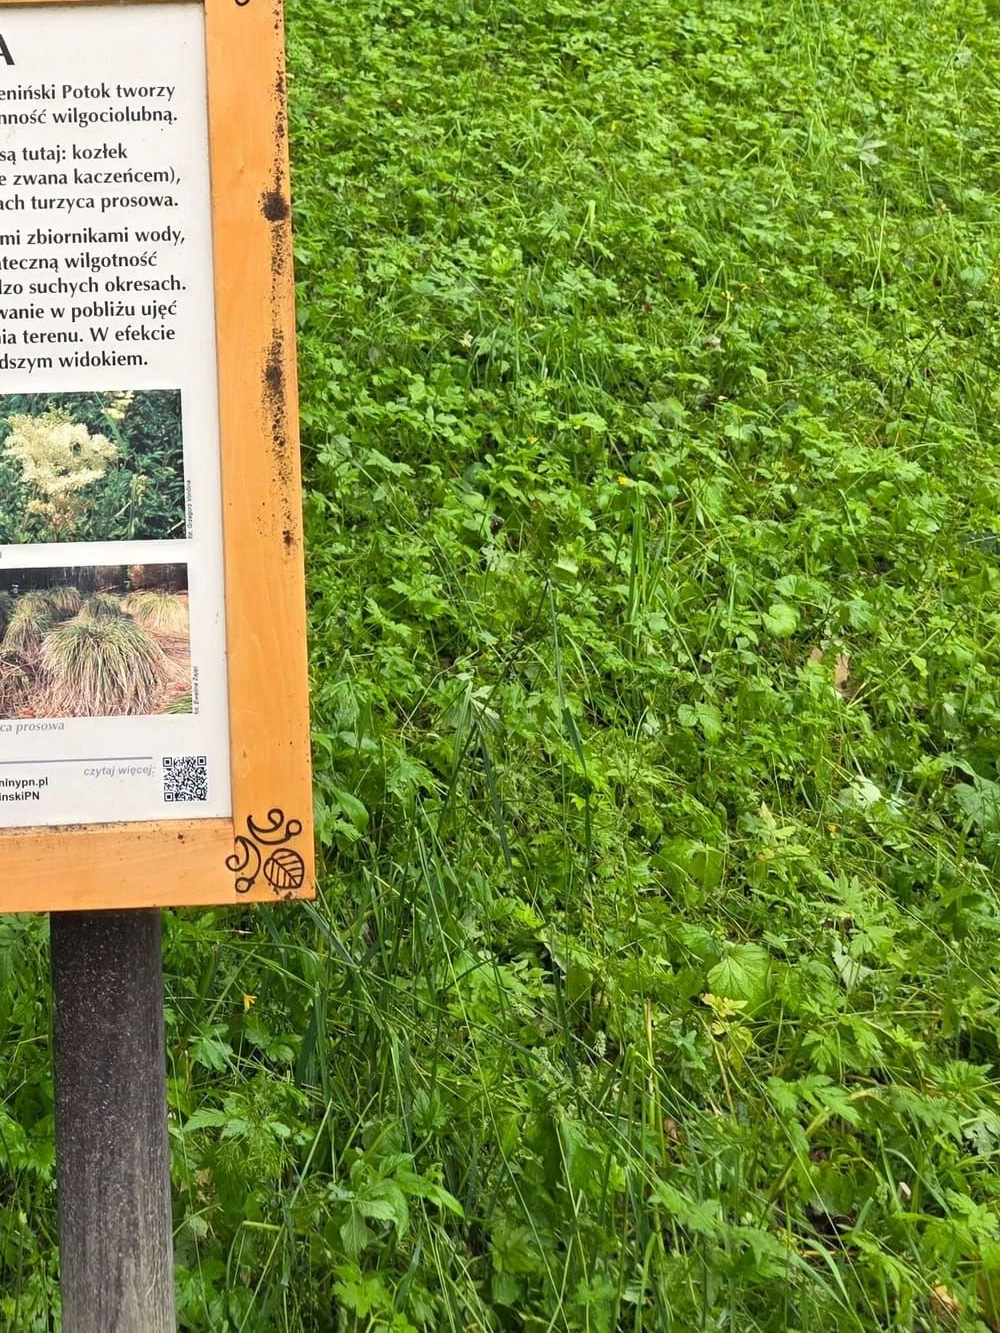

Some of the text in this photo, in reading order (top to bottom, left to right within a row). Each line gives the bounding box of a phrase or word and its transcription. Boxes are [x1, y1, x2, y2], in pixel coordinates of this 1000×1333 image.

[63, 83, 110, 98] Potok
[117, 85, 175, 101] tworzy
[53, 106, 177, 127] wilgociolubną.
[0, 151, 16, 165] są
[22, 145, 65, 163] tutaj:
[73, 143, 127, 159] kozłek
[13, 174, 67, 185] zwana
[74, 168, 180, 184] kaczeńcem),
[31, 196, 94, 213] turzyca
[101, 196, 178, 212] prosowa.
[27, 227, 128, 244] zbiornikami
[135, 226, 184, 246] wody,
[65, 251, 156, 272] wilgotność
[30, 277, 98, 297] suchych
[105, 275, 186, 292] okresach.
[51, 308, 64, 318] w
[72, 301, 135, 322] pobliżu
[142, 300, 176, 319] ujęć
[23, 330, 83, 344] terenu.
[90, 327, 108, 341] W
[115, 325, 175, 341] efekcie
[59, 351, 147, 367] widokiem.
[16, 723, 64, 734] prosowa
[84, 765, 155, 777] czytaj więcej:
